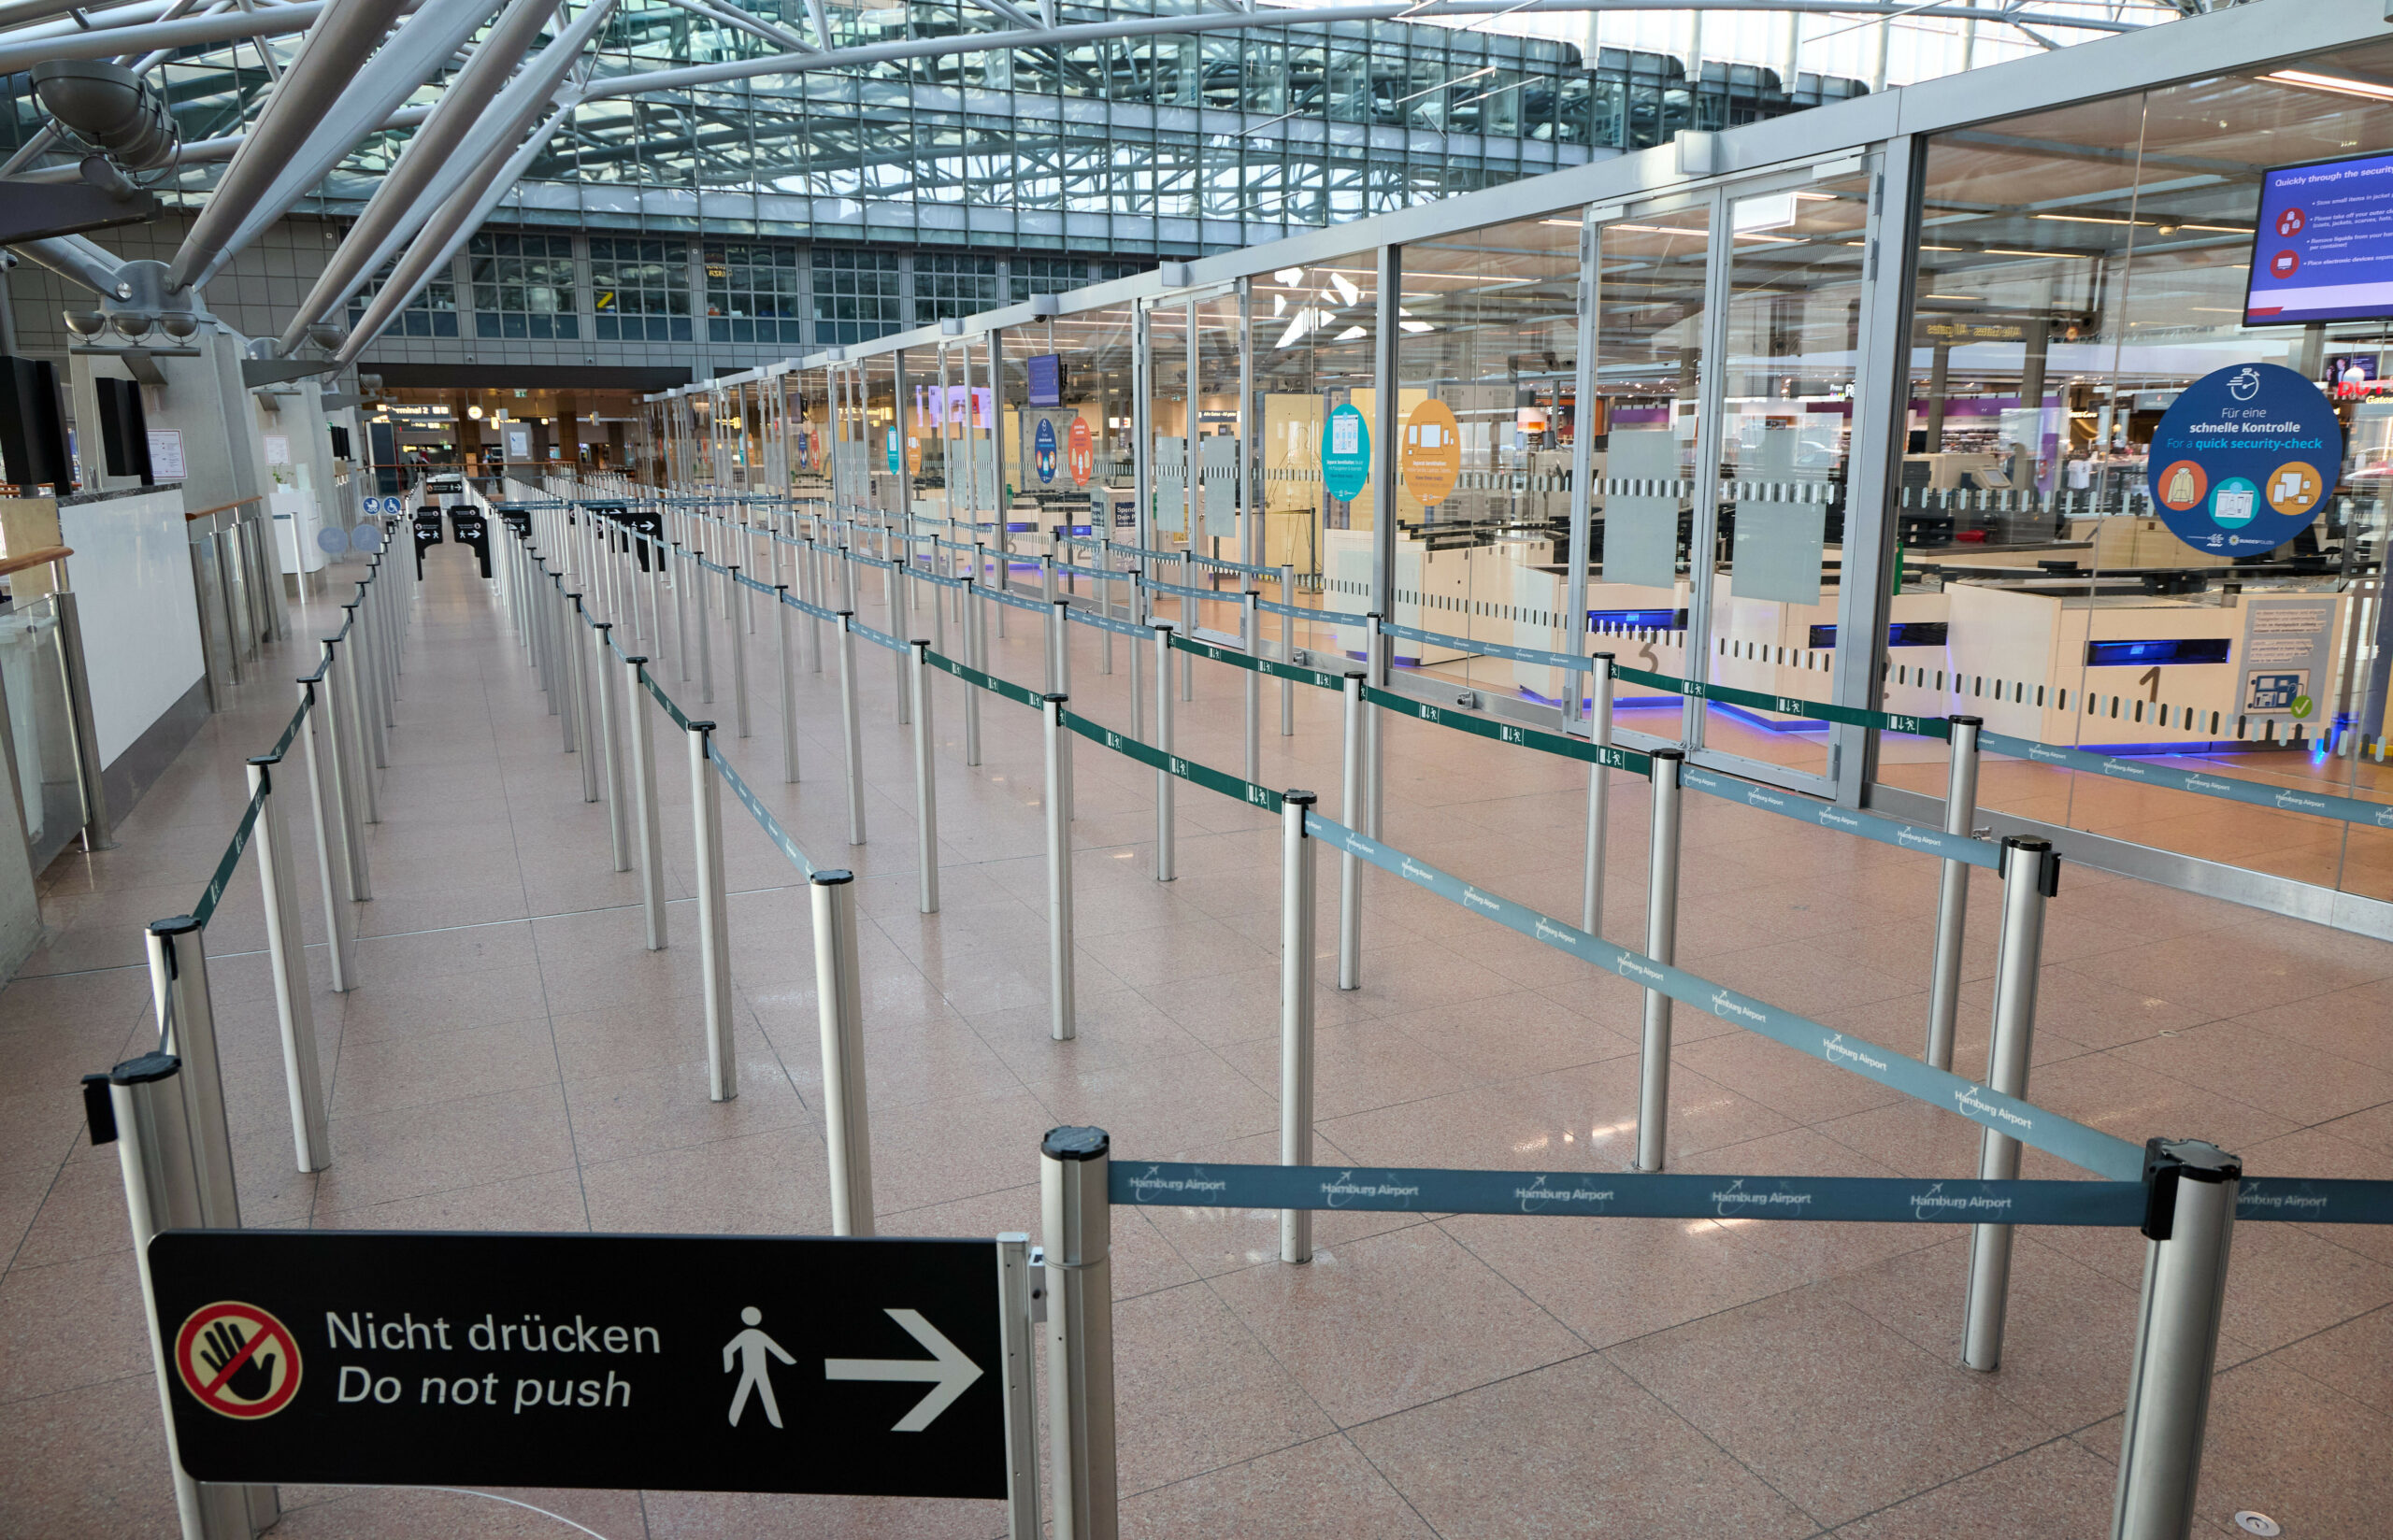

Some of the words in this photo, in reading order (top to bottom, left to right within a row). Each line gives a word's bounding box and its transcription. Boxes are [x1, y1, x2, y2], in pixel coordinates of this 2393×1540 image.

[2275, 177, 2307, 187] Quickly
[2308, 171, 2342, 182] through
[2344, 169, 2358, 178] the
[2372, 192, 2390, 201] jacket
[2221, 407, 2240, 419] Für
[2243, 408, 2267, 418] eine
[2189, 421, 2240, 434] schnelle
[2242, 421, 2301, 433] Kontrolle
[2167, 438, 2185, 449] For
[2186, 440, 2193, 449] a
[2196, 437, 2228, 451] quick
[2230, 437, 2323, 451] security-check
[2139, 665, 2161, 707] 1
[2185, 777, 2211, 789] Hamburg
[2211, 782, 2230, 791] Airport
[2275, 793, 2302, 806] Hamburg
[2302, 798, 2325, 808] Airport
[1897, 830, 1922, 844] Hamburg
[1922, 836, 1942, 848] Airport
[1535, 920, 1558, 938] Hamburg
[1558, 930, 1576, 945] Airport
[1617, 955, 1643, 975] Hamburg
[1643, 966, 1664, 982] Airport
[1712, 993, 1742, 1015] Hamburg
[1742, 1005, 1766, 1023] Airport
[1823, 1038, 1858, 1062] Hamburg
[1859, 1052, 1887, 1072] Airport
[1955, 1090, 1997, 1118] Hamburg
[1999, 1106, 2032, 1130] Airport
[1129, 1177, 1183, 1191] Hamburg
[1184, 1178, 1226, 1191] Airport
[1322, 1182, 1376, 1197] Hamburg
[1378, 1183, 1419, 1197] Airport
[1515, 1188, 1570, 1202] Hamburg
[1571, 1188, 1614, 1202] Airport
[1712, 1191, 1768, 1205] Hamburg
[1770, 1191, 1812, 1205] Airport
[1911, 1194, 1967, 1209] Hamburg
[1969, 1196, 2012, 1209] Airport
[2237, 1195, 2282, 1208] amburg
[2284, 1195, 2328, 1207] Airport
[325, 1311, 452, 1349] Nicht
[468, 1314, 661, 1353] drücken
[337, 1366, 402, 1404] Do
[421, 1371, 498, 1405] not
[513, 1370, 632, 1415] push
